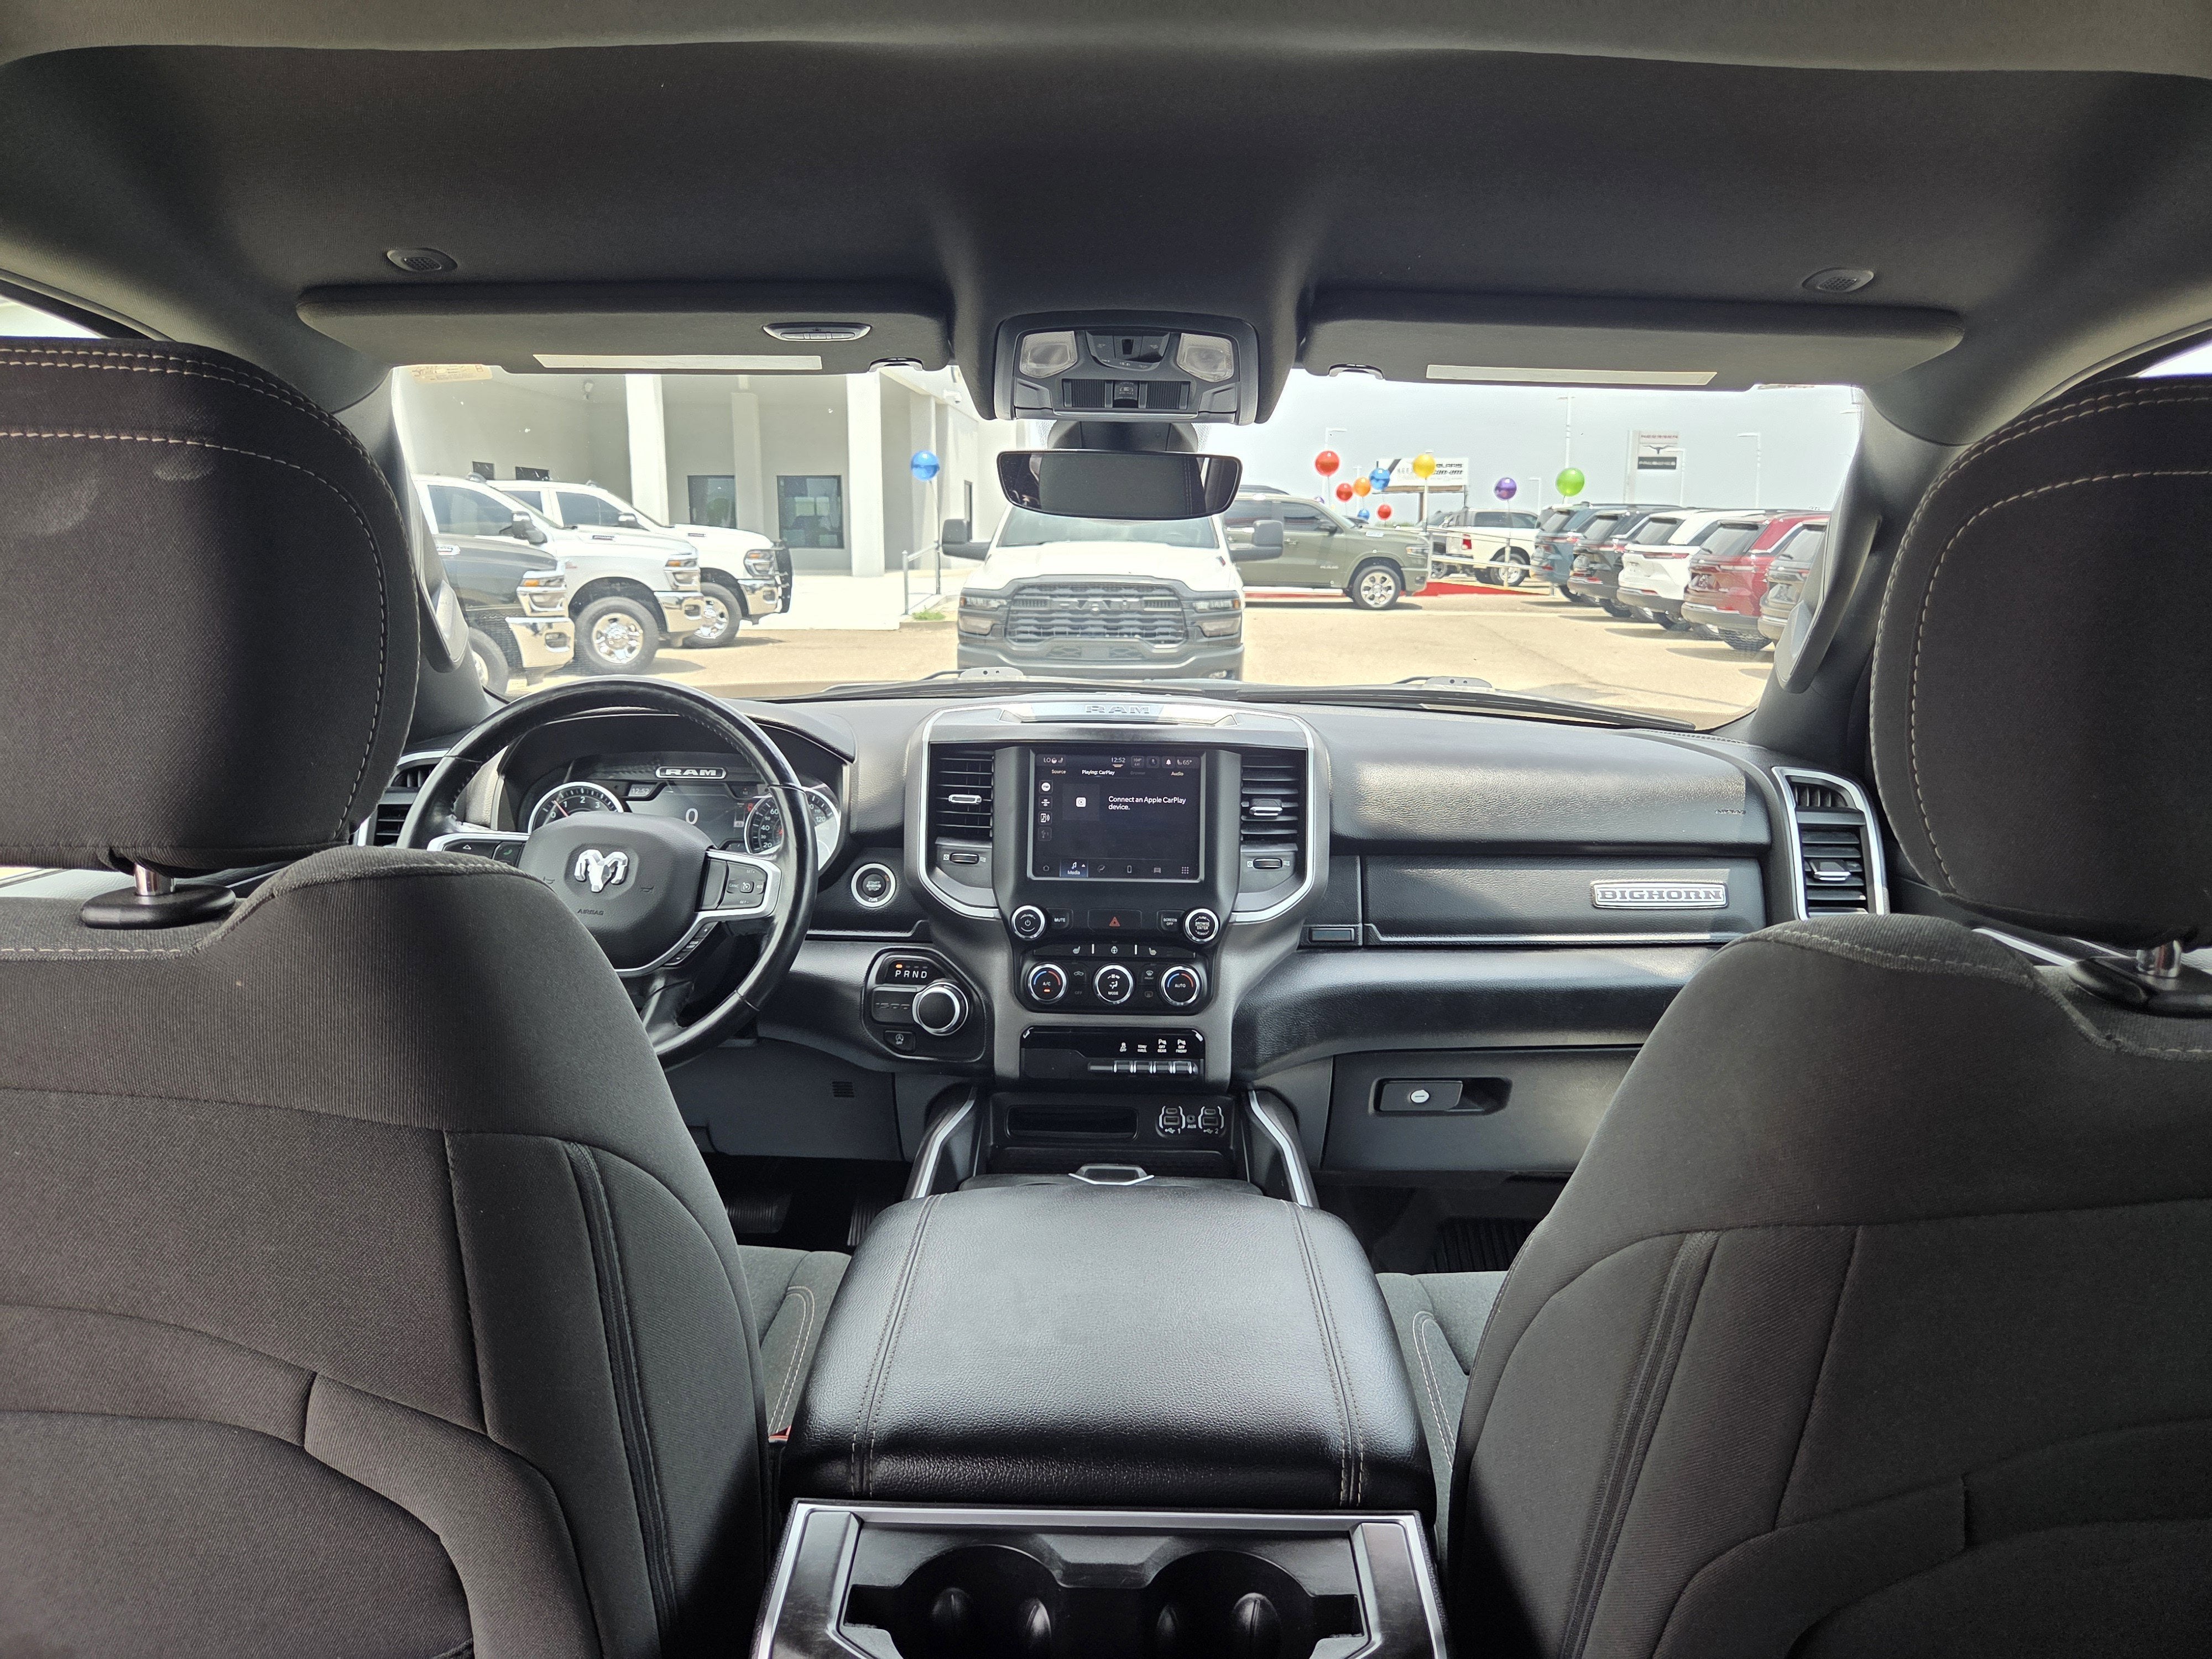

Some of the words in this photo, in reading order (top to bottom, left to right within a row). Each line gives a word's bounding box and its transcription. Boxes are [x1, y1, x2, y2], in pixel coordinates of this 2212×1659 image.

[1085, 705, 1150, 714] RAM
[685, 808, 698, 825] 0
[1599, 890, 1721, 900] BIGHORN
